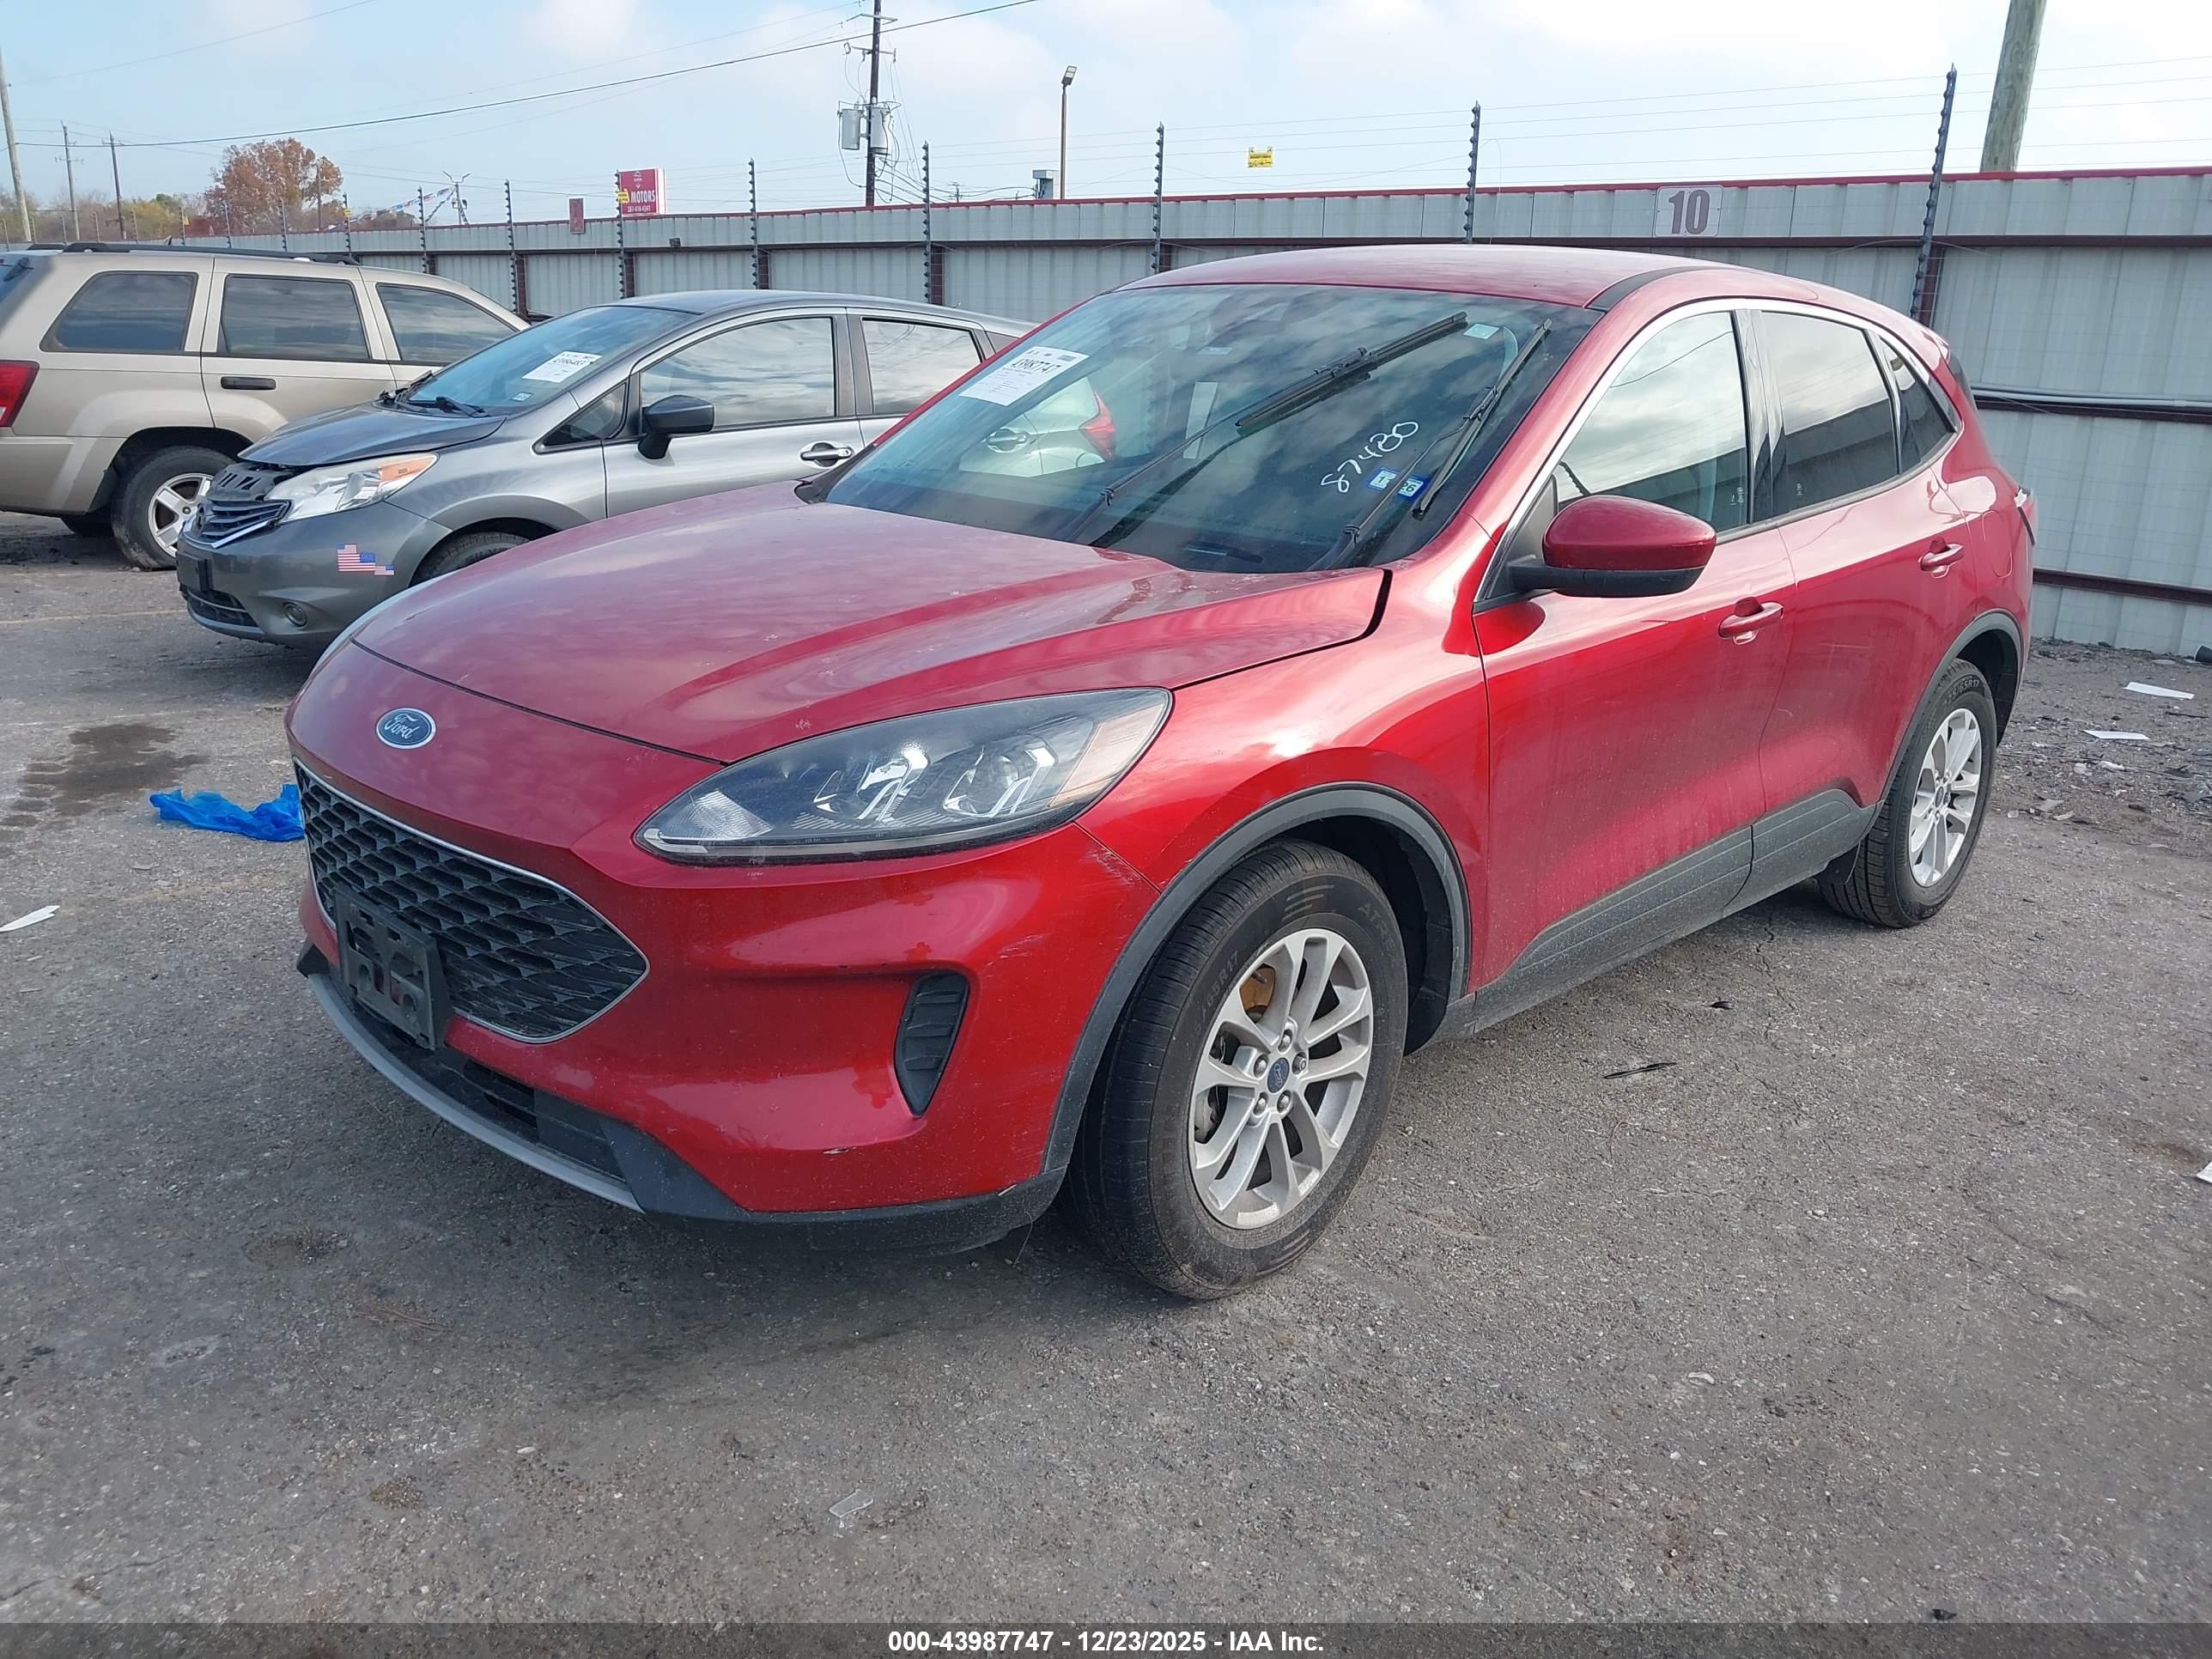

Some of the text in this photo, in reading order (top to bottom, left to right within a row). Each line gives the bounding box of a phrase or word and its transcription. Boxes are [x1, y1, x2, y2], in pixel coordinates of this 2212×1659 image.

[630, 190, 655, 204] MOTORS
[1668, 189, 1711, 234] 10
[383, 713, 420, 739] Ford
